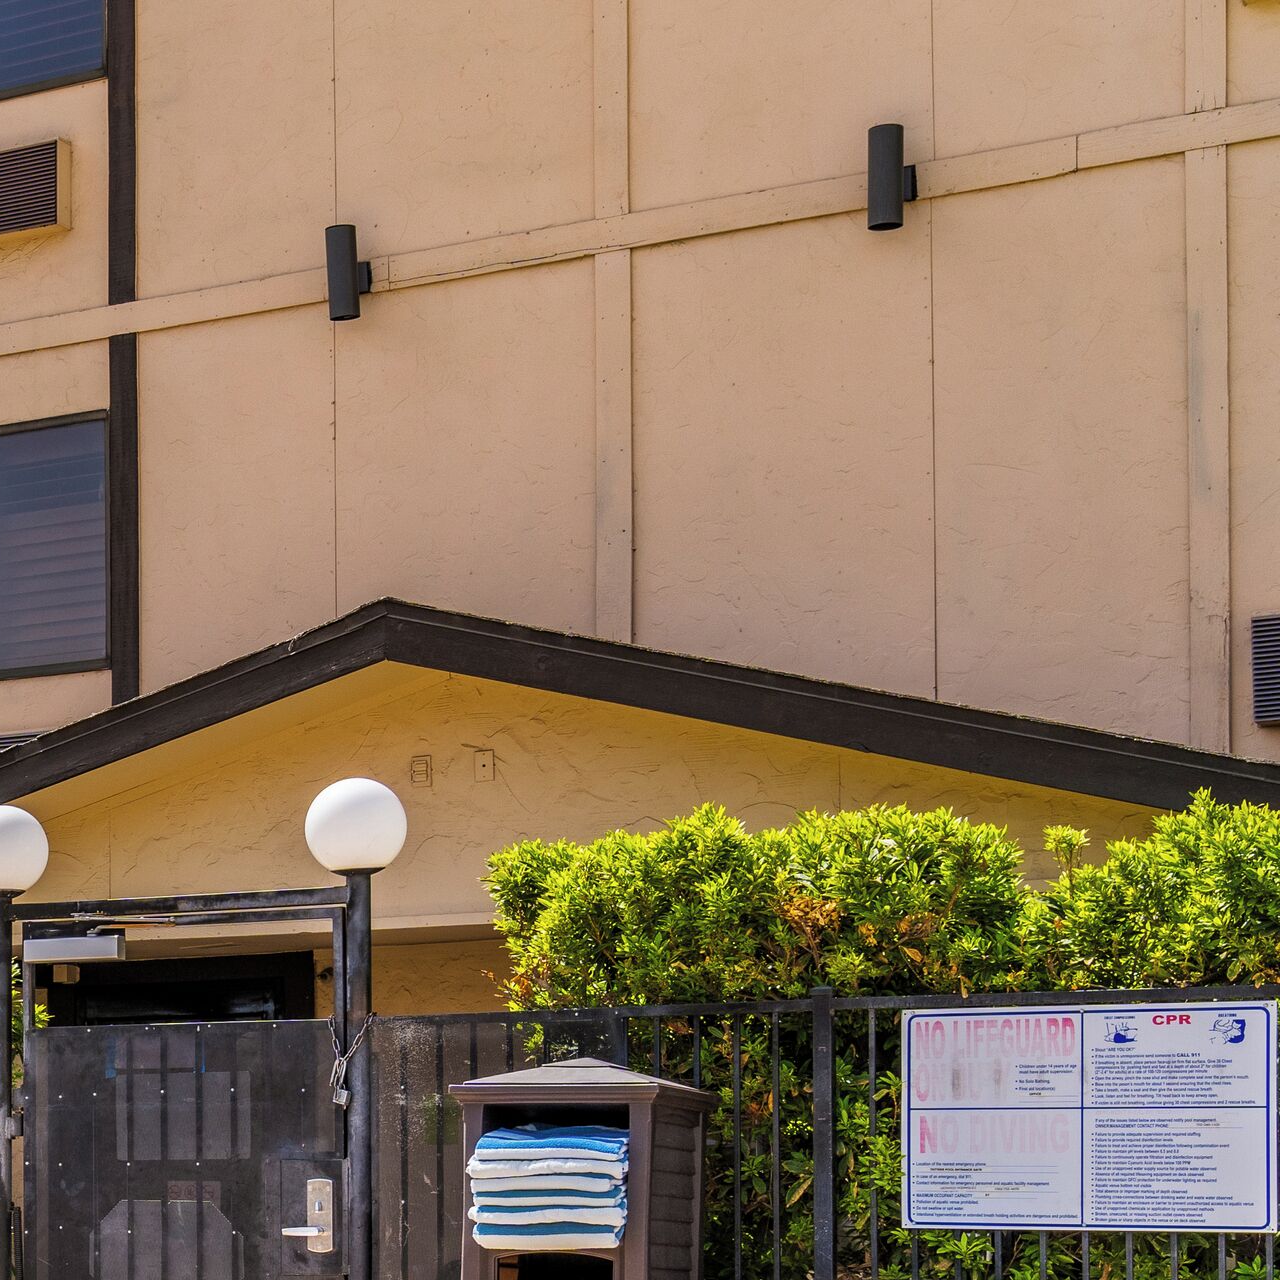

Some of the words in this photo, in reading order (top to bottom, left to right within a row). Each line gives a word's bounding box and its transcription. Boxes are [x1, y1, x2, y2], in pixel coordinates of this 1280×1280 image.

[915, 1019, 946, 1059] NO
[951, 1018, 1075, 1058] LIFEGUARD
[1152, 1014, 1191, 1025] CPR
[920, 1115, 962, 1153] NO
